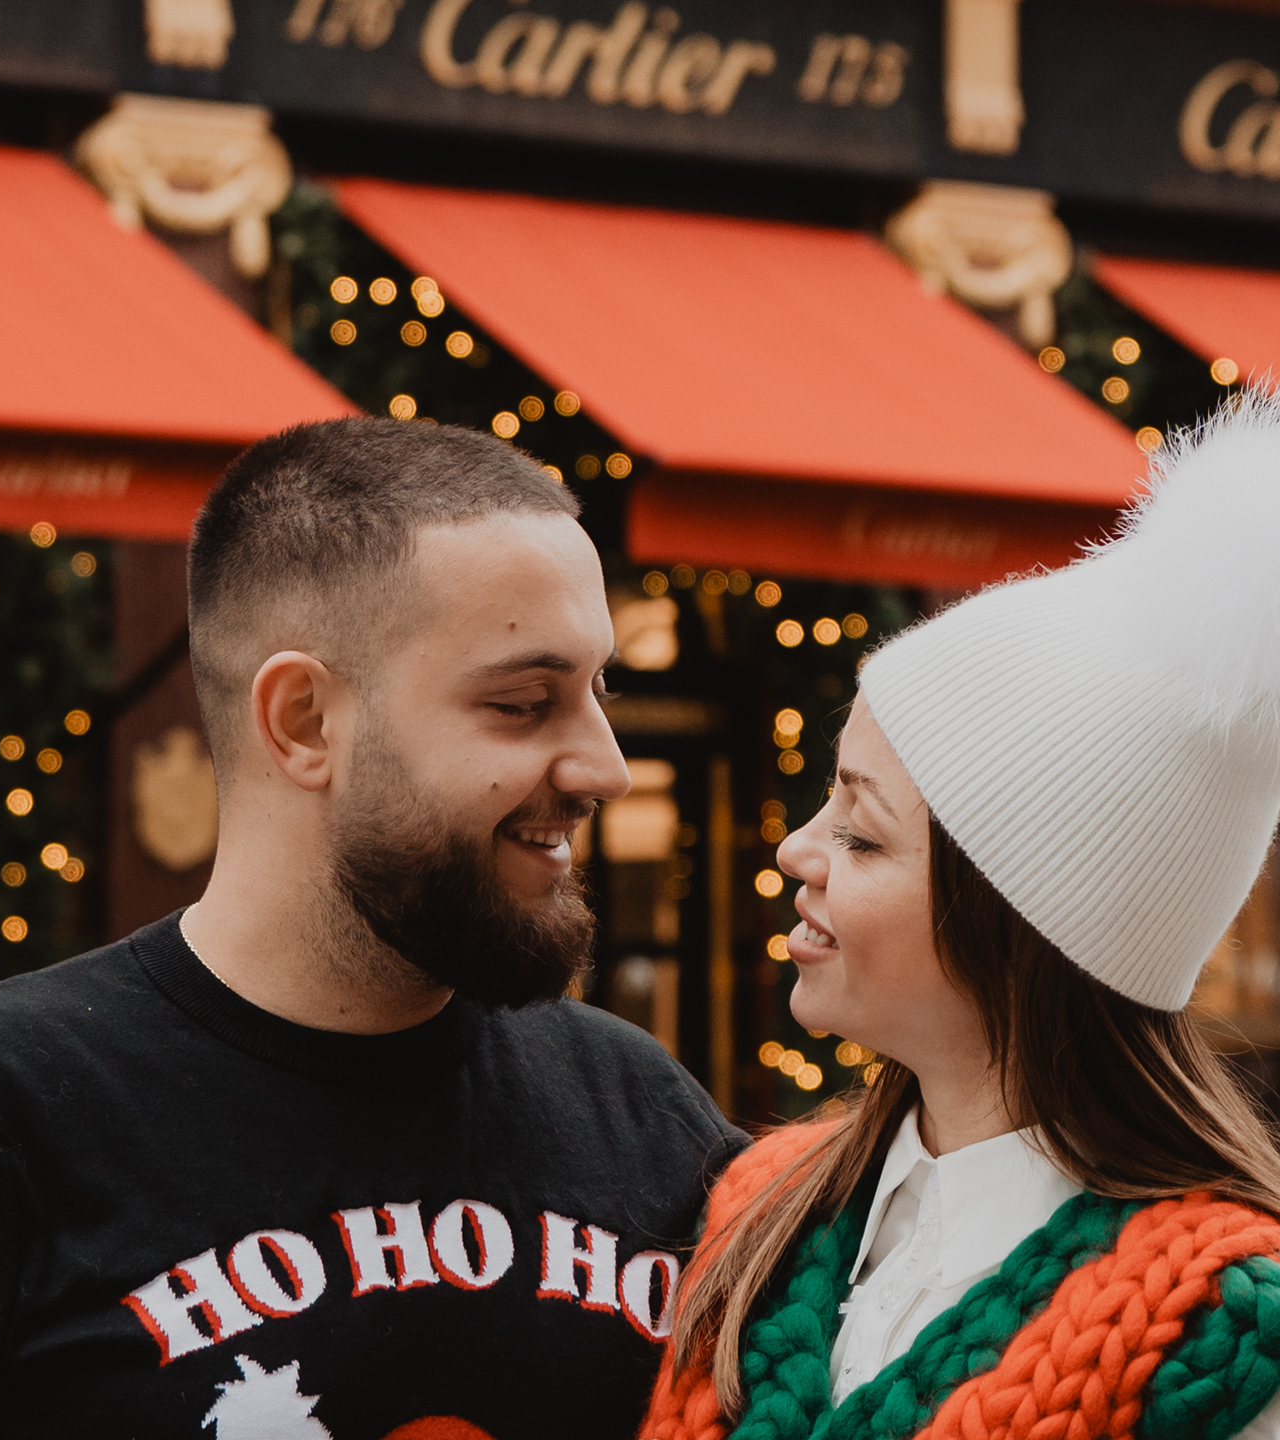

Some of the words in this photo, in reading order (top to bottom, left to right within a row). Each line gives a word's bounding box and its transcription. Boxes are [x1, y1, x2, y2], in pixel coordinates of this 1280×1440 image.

[121, 1228, 327, 1367] HO
[331, 1199, 515, 1299] HO
[535, 1210, 680, 1344] HO
